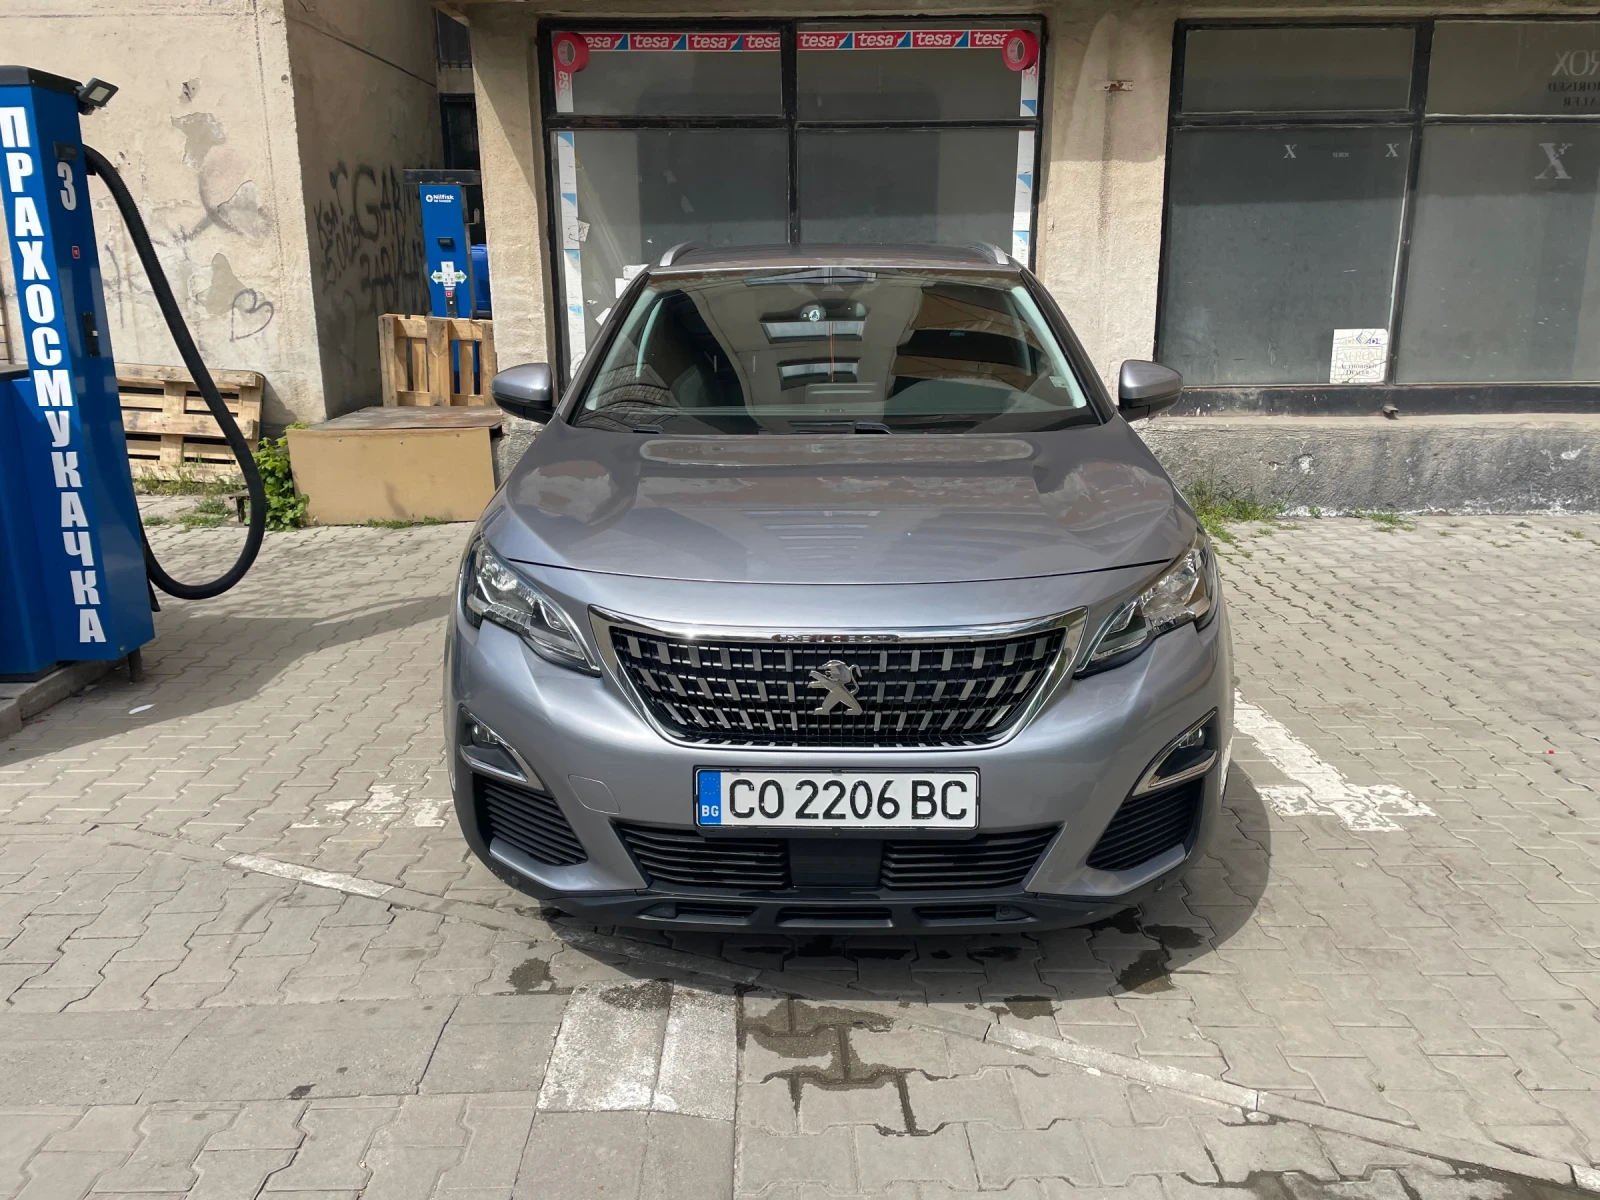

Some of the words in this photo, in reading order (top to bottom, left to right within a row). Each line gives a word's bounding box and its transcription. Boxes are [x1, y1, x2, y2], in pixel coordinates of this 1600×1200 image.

[585, 35, 612, 48] esa
[633, 34, 668, 49] tesa
[691, 35, 727, 49] tesa
[746, 35, 781, 49] tesa
[800, 33, 836, 47] tesa
[858, 33, 894, 47] tesa
[916, 32, 951, 46] tesa
[1535, 142, 1573, 180] X
[57, 161, 77, 211] 3
[1, 106, 107, 643] ПРАХОСМУКАЧКА
[701, 805, 719, 817] BG
[729, 778, 785, 819] CO
[795, 779, 901, 820] 2206
[911, 780, 968, 820] BC
